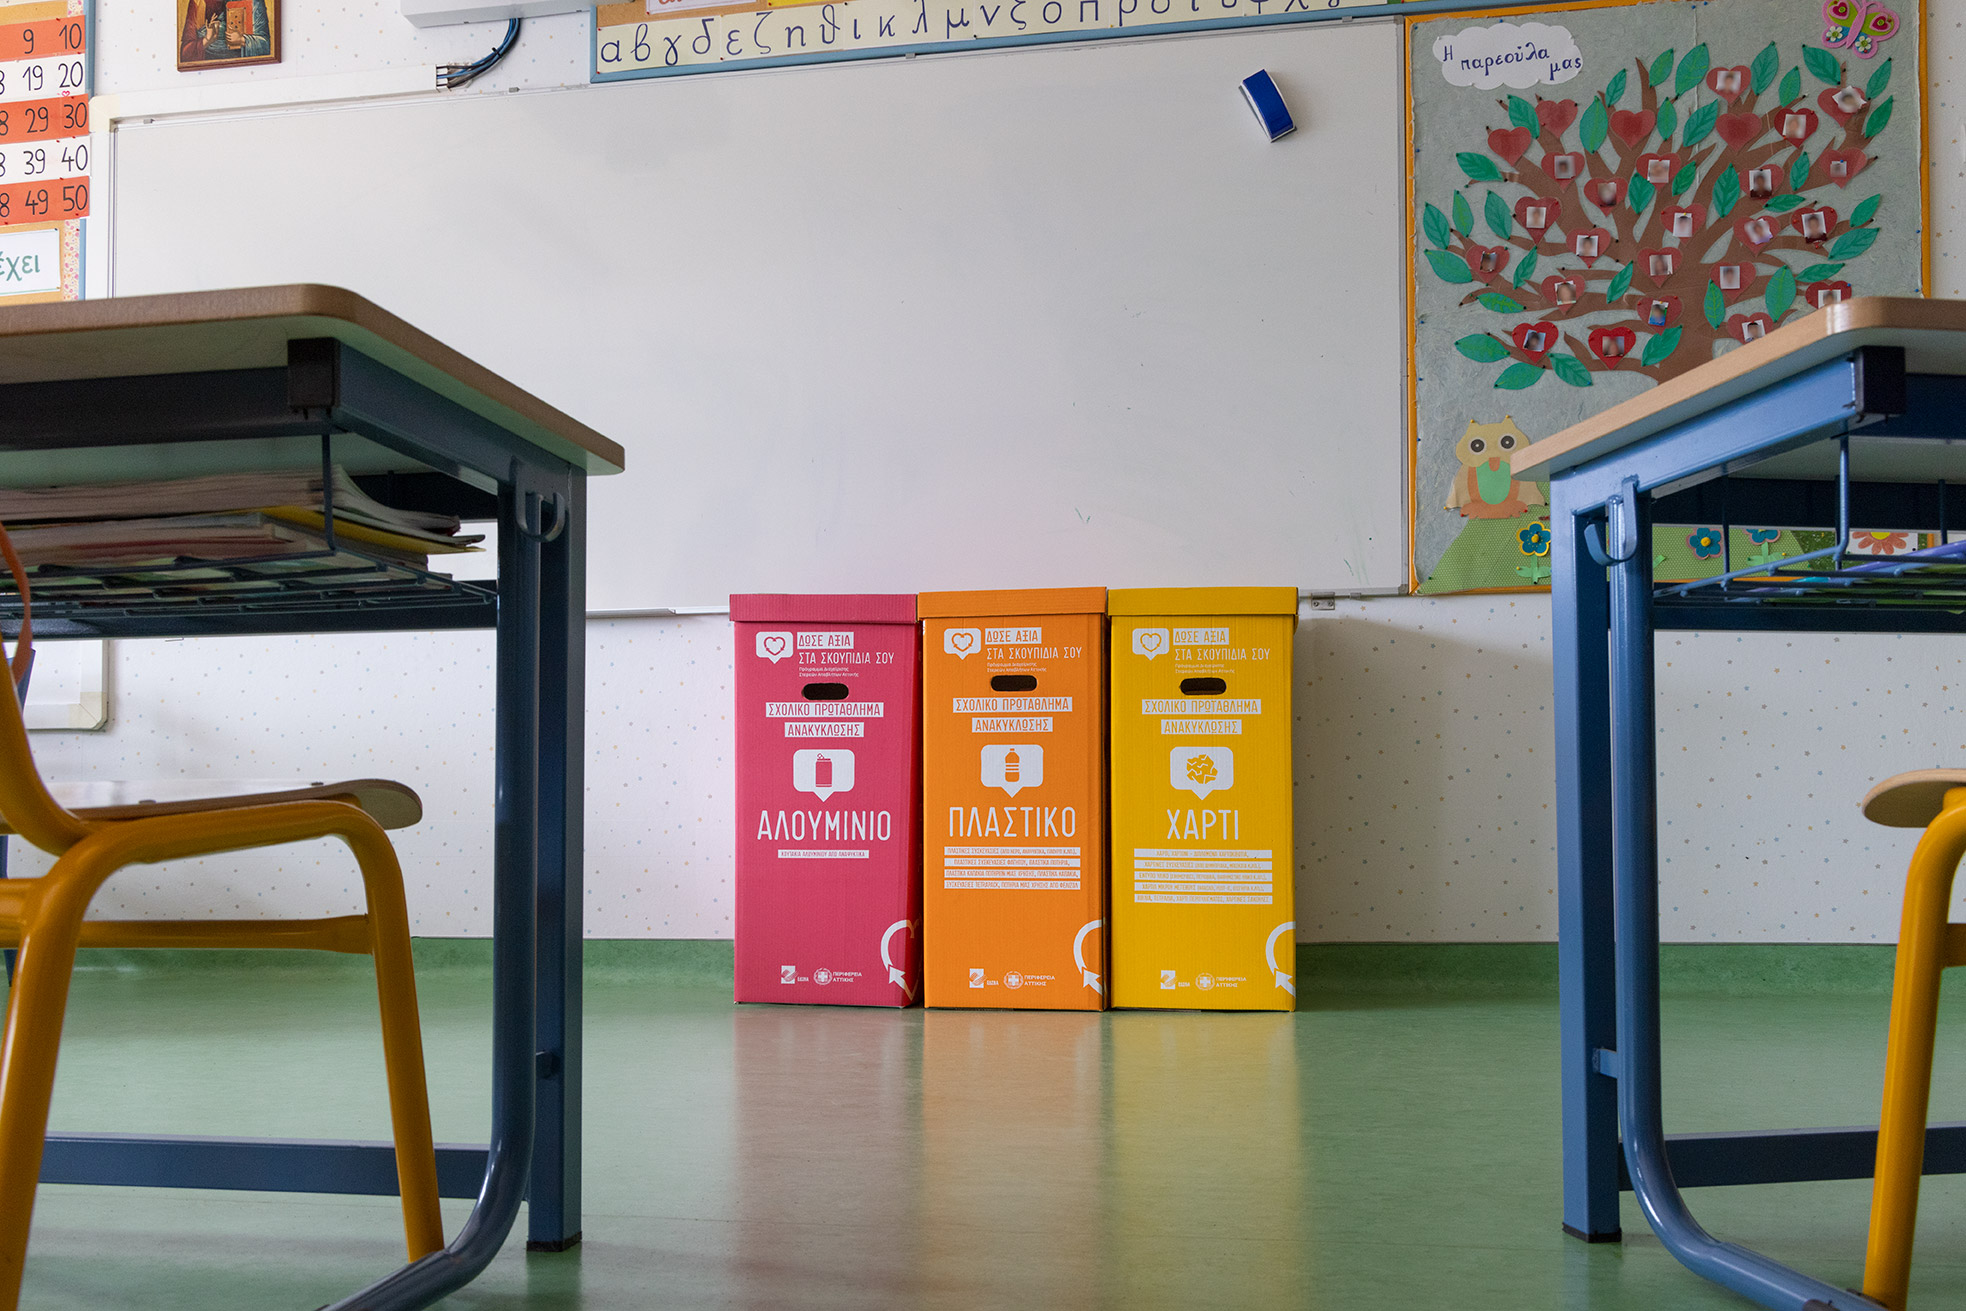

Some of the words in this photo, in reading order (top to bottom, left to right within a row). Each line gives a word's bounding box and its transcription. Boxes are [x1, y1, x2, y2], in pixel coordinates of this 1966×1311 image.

[23, 29, 34, 54] 9
[59, 23, 82, 49] 10
[1461, 42, 1550, 76] παρεούλα
[1550, 57, 1581, 80] μας
[22, 65, 43, 91] 19
[58, 61, 83, 88] 20
[25, 106, 49, 133] 29
[63, 102, 87, 129] 30
[23, 149, 46, 175] 39
[61, 144, 88, 172] 40
[25, 189, 48, 215] 49
[63, 184, 88, 212] 50
[799, 635, 823, 646] ΔΩΣΕ
[828, 634, 851, 646] ΑΞΙΑ
[987, 631, 1011, 642] ΔΩΣΕ
[1015, 630, 1038, 642] ΑΞΙΑ
[1174, 631, 1199, 643] ΔΩΣΕ
[1203, 631, 1226, 643] ΑΞΙΑ
[799, 652, 816, 664] ΣΤΑ
[821, 652, 871, 664] ΣΚΟΥΠΙΔΙΑ
[875, 652, 894, 664] ΣΟΥ
[987, 648, 1004, 659] ΣΤΑ
[1009, 647, 1059, 659] ΣΚΟΥΠΙΔΙΑ
[1063, 647, 1082, 658] ΣΟΥ
[1175, 649, 1192, 661] ΣΤΑ
[1197, 648, 1247, 661] ΣΚΟΥΠΙΔΙΑ
[1251, 648, 1270, 660] ΣΟΥ
[768, 703, 810, 716] ΣΧΟΛΙΚΟ
[814, 703, 880, 716] ΠΡΩΤΑΘΛΗΜΑ
[956, 699, 998, 711] ΣΧΟΛΙΚΟ
[1002, 698, 1069, 711] ΠΡΩΤΑΘΛΗΜΑ
[1144, 701, 1186, 713] ΣΧΟΛΙΚΟ
[1191, 701, 1258, 713] ΠΡΩΤΑΘΛΗΜΑ
[787, 724, 860, 736] ΑΝΑΚΥΚΛΩΣΗΣ
[975, 719, 1049, 732] ΑΝΑΚΥΚΛΩΣΗΣ
[1164, 721, 1238, 733] ΑΝΑΚΥΚΛΩΣΗΣ
[757, 810, 891, 841] ΑΛΟΥΜΙΝΙΟ
[949, 807, 1075, 837] ΠΛΑΣΤΙΚΟ
[1167, 809, 1239, 840] ΧΑΡΤΙ
